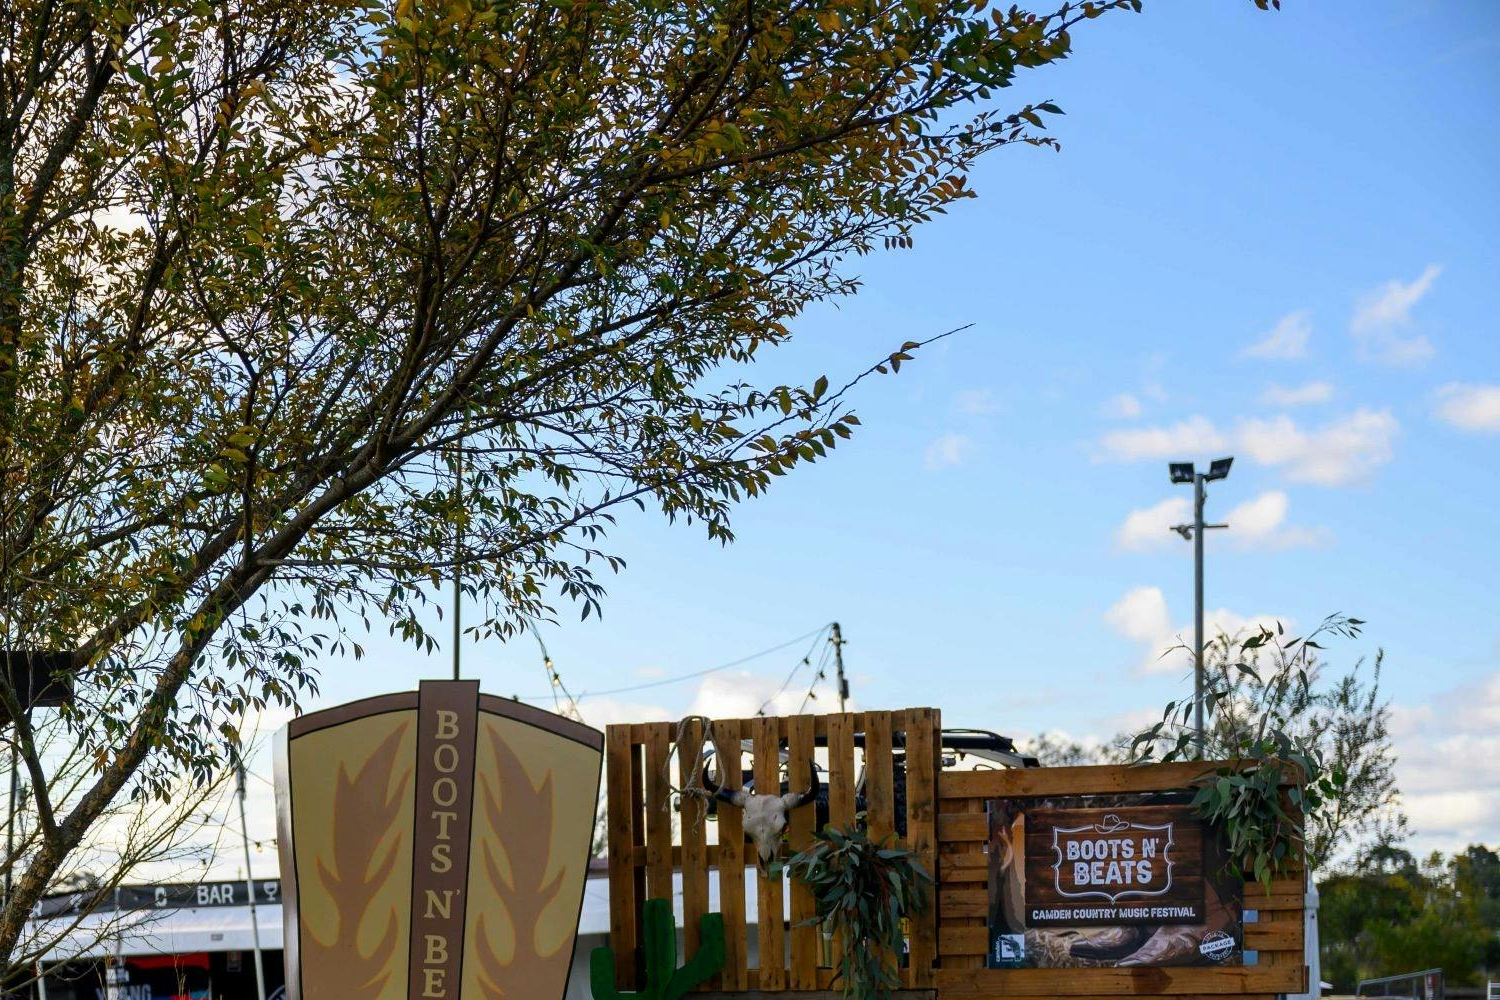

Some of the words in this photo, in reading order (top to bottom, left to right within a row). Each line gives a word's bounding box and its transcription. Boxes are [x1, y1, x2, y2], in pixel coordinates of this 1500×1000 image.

[430, 709, 460, 874] BOOTS
[1067, 839, 1135, 861] BOOTS
[1142, 837, 1159, 858] N'
[1074, 860, 1153, 886] BEATS
[197, 884, 234, 905] BAR
[422, 888, 462, 919] N'
[1032, 909, 1072, 920] CAMDEN
[1073, 908, 1117, 919] COUNTRY
[1119, 908, 1150, 919] MUSIC
[1150, 906, 1196, 918] FESTIVAL
[1202, 939, 1232, 951] PACKAGE
